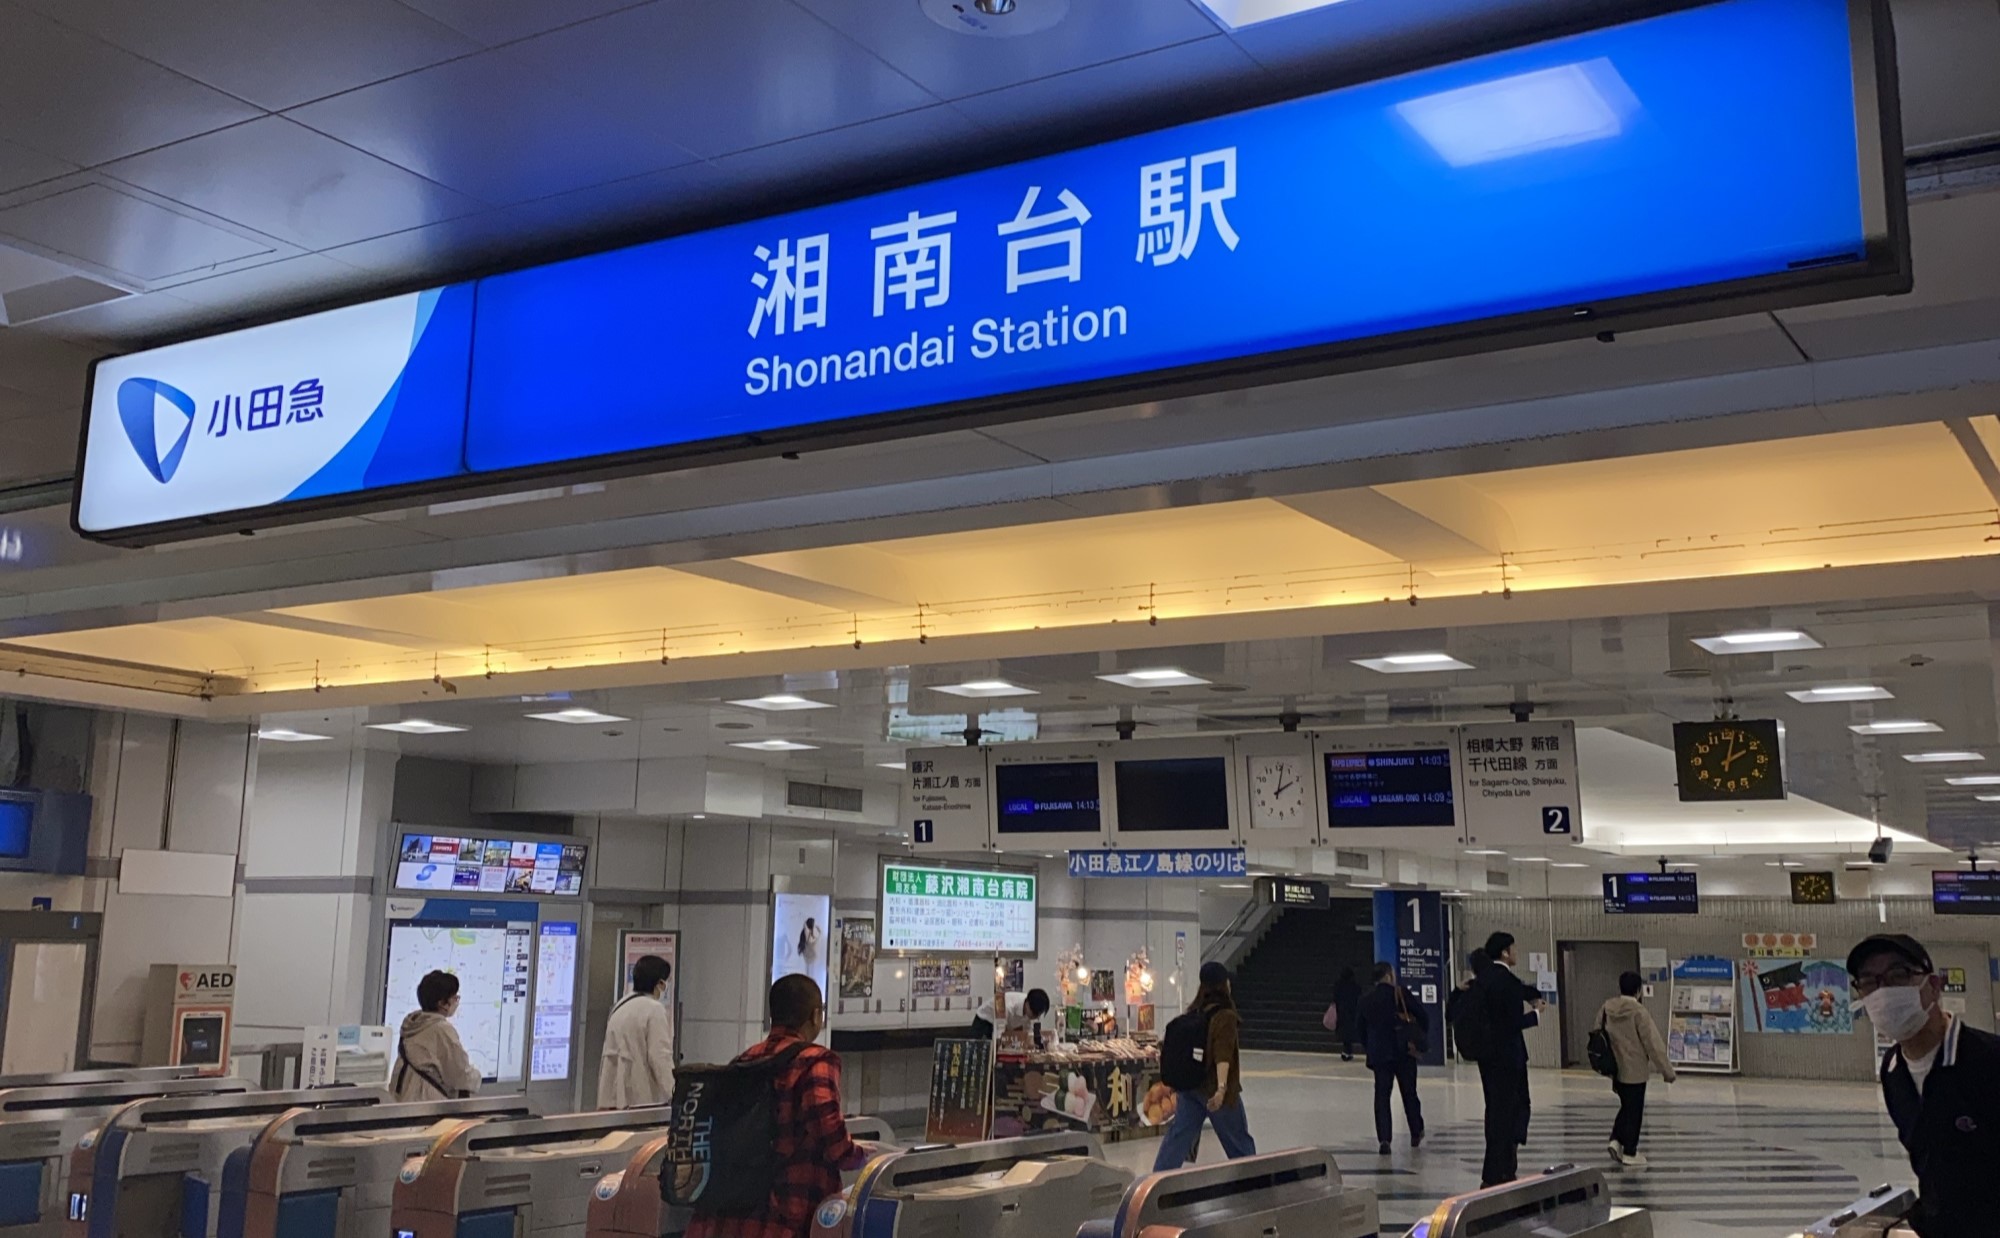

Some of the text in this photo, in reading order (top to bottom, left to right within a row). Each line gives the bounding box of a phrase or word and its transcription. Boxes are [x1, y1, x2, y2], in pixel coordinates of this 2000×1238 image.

[748, 147, 1240, 339] 湘南台駅
[745, 304, 1128, 396] Shonandai Station
[207, 378, 325, 438] 小田急
[1467, 737, 1523, 753] 相模大野
[1531, 736, 1559, 751] 新宿
[912, 761, 933, 773] 藤沢
[1376, 757, 1415, 766] SHINJUKU
[1420, 756, 1441, 766] 14:03
[1468, 756, 1558, 772] 千代田線 方面
[912, 775, 960, 789] 片瀬江ノ島
[1469, 779, 1479, 787] for
[1423, 792, 1445, 802] 14:09
[1482, 789, 1531, 798] Chiyoda Line
[1008, 800, 1095, 811] LOCAL FUJISAWA 14:13
[1548, 809, 1564, 832] 2
[919, 822, 926, 841] 1
[1069, 852, 1246, 874] 小田急江ノ島線のりば
[924, 874, 1029, 899] 藤沢湘南台病院
[1272, 882, 1276, 902] 1
[1608, 876, 1618, 898] 1
[1407, 898, 1420, 933] 1
[196, 972, 233, 988] AED
[677, 1082, 704, 1162] NORTH
[692, 1115, 713, 1162] THE
